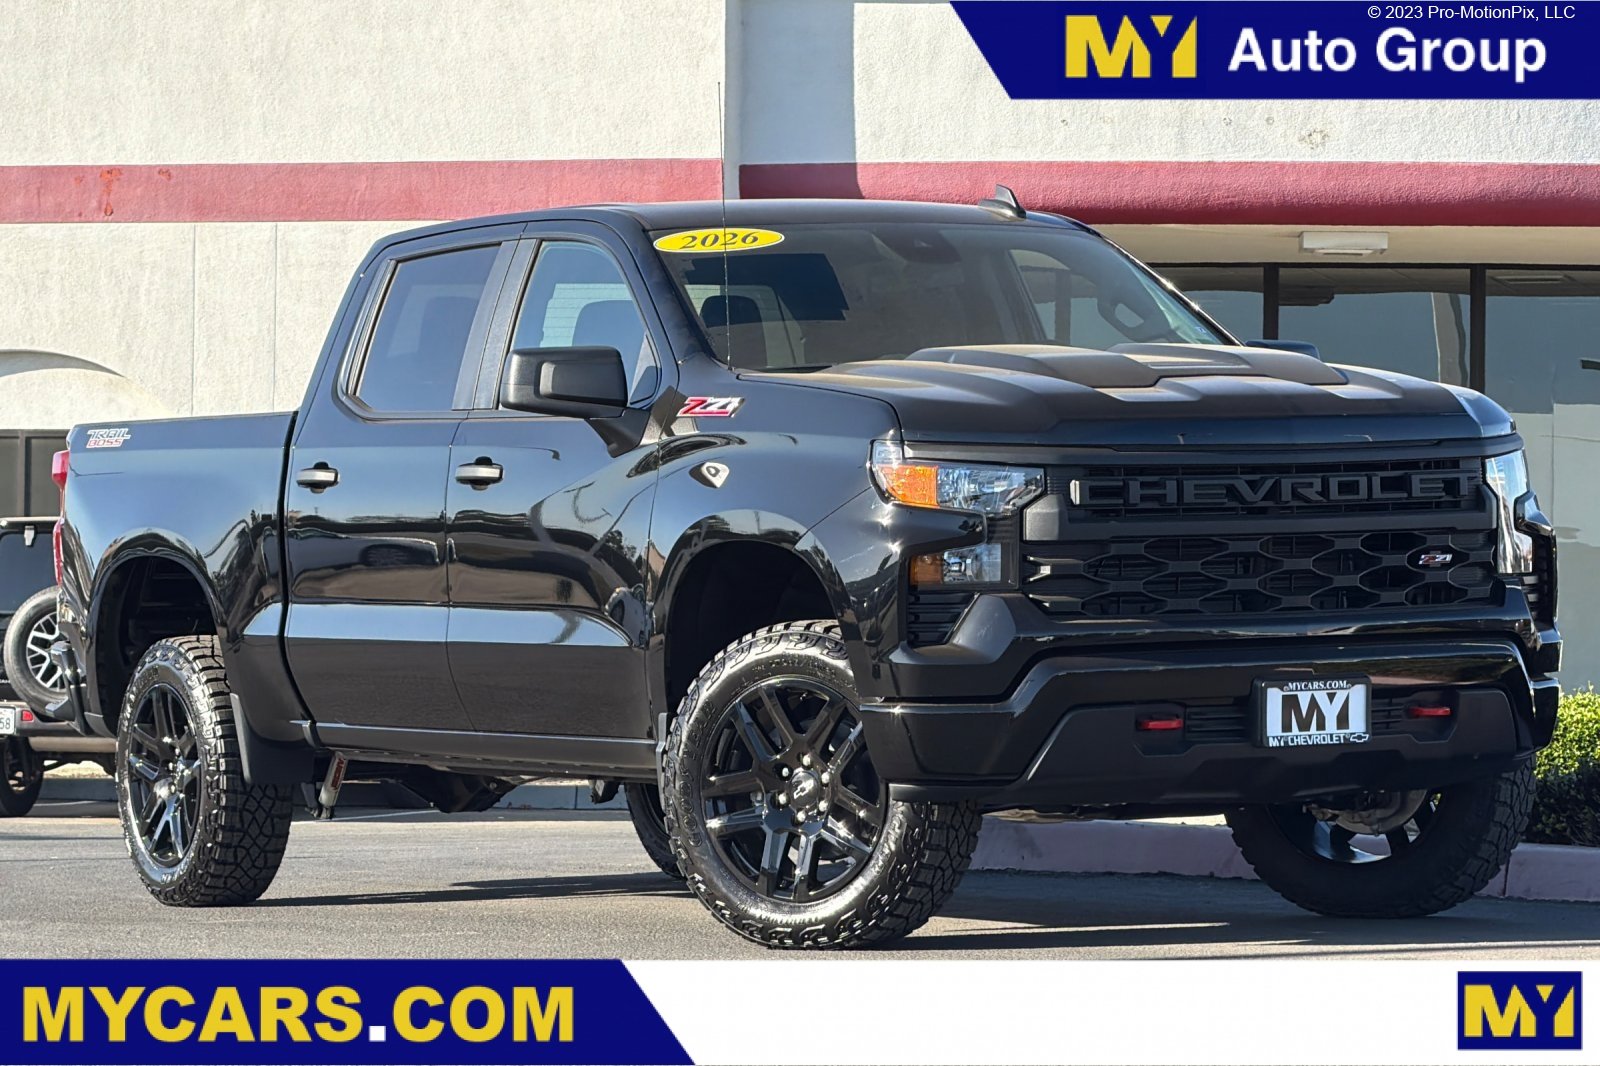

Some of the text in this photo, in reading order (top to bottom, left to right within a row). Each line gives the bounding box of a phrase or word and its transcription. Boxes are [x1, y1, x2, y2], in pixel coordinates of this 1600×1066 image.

[680, 232, 760, 249] 2026
[676, 396, 746, 417] Z71
[87, 428, 131, 440] TRAIL
[86, 439, 124, 448] BOSS
[1069, 471, 1480, 506] CHEVROLET
[1288, 680, 1347, 691] MYCARS.COM
[1281, 692, 1349, 733] MY
[1288, 733, 1345, 746] CHEVROLET
